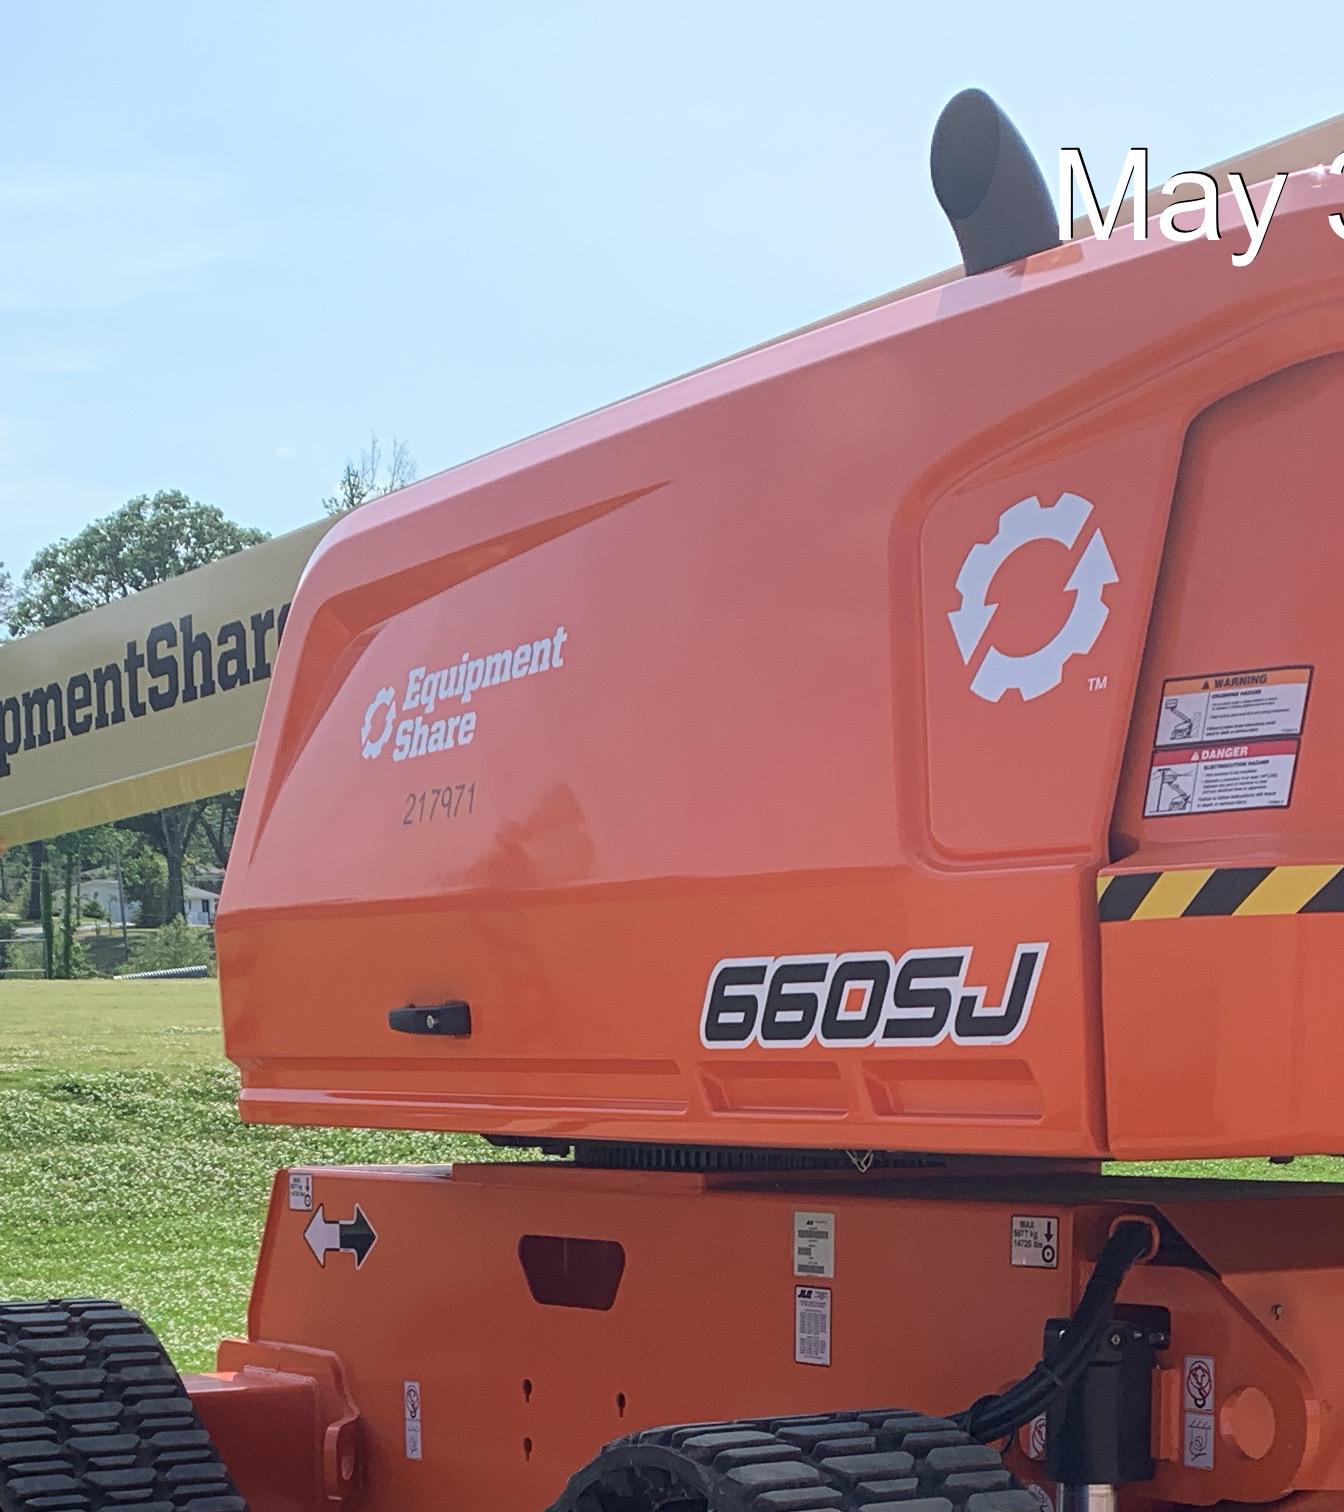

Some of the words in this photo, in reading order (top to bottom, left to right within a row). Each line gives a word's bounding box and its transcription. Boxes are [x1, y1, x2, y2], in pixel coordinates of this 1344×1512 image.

[401, 626, 568, 714] Equipment
[1088, 675, 1108, 692] TM
[1213, 673, 1268, 689] WARNING
[392, 711, 477, 762] Share
[1201, 745, 1249, 761] DANGER
[402, 780, 477, 826] 217971
[701, 943, 1048, 1048] 660SJ
